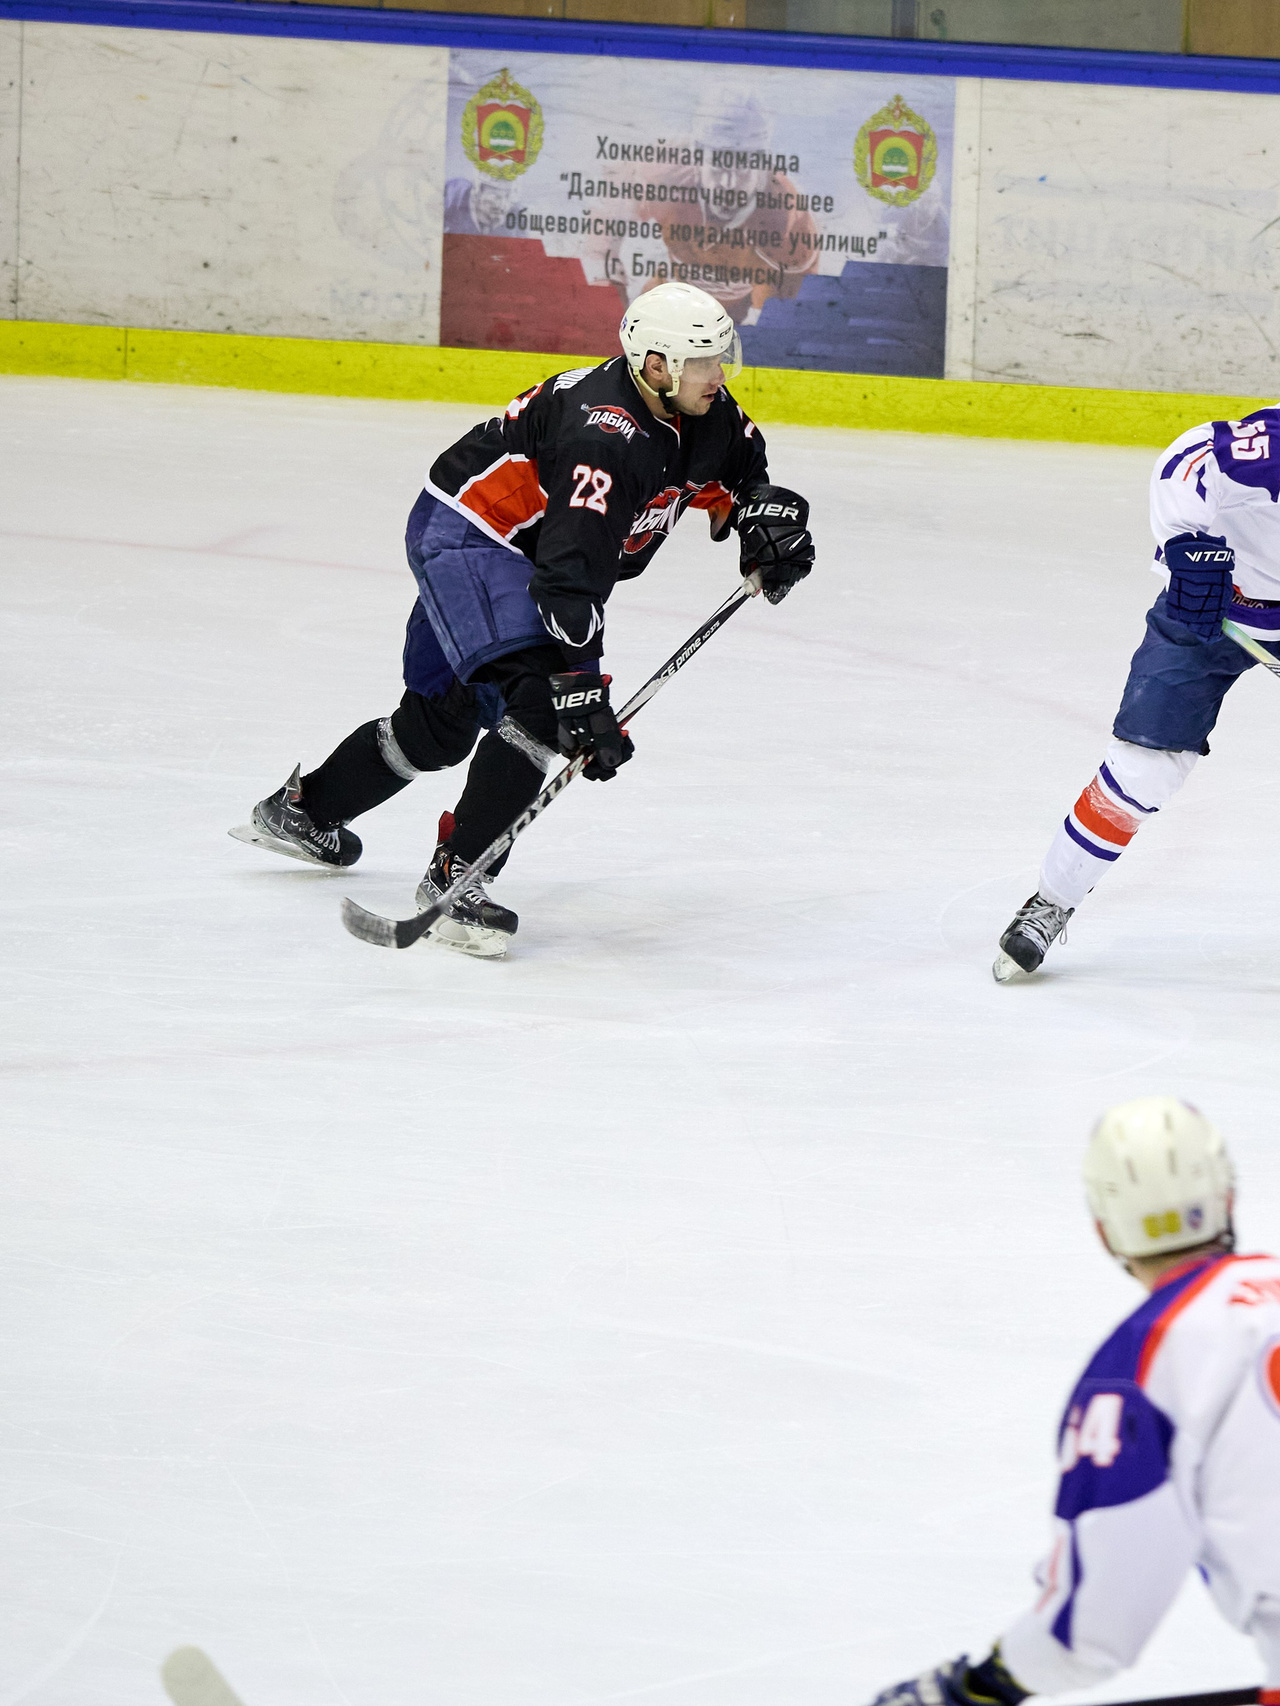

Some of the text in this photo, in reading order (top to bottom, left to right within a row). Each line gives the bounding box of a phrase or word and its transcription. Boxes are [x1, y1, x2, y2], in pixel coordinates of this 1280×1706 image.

[596, 135, 799, 175] Хоккейная команда
[756, 190, 833, 214] высшее
[505, 207, 662, 240] общевойсковое
[670, 223, 782, 249] командное
[604, 249, 785, 288] (г. Благовещенск)
[587, 410, 637, 440] ДАБИИ
[1227, 420, 1269, 460] 55
[568, 463, 613, 516] 28
